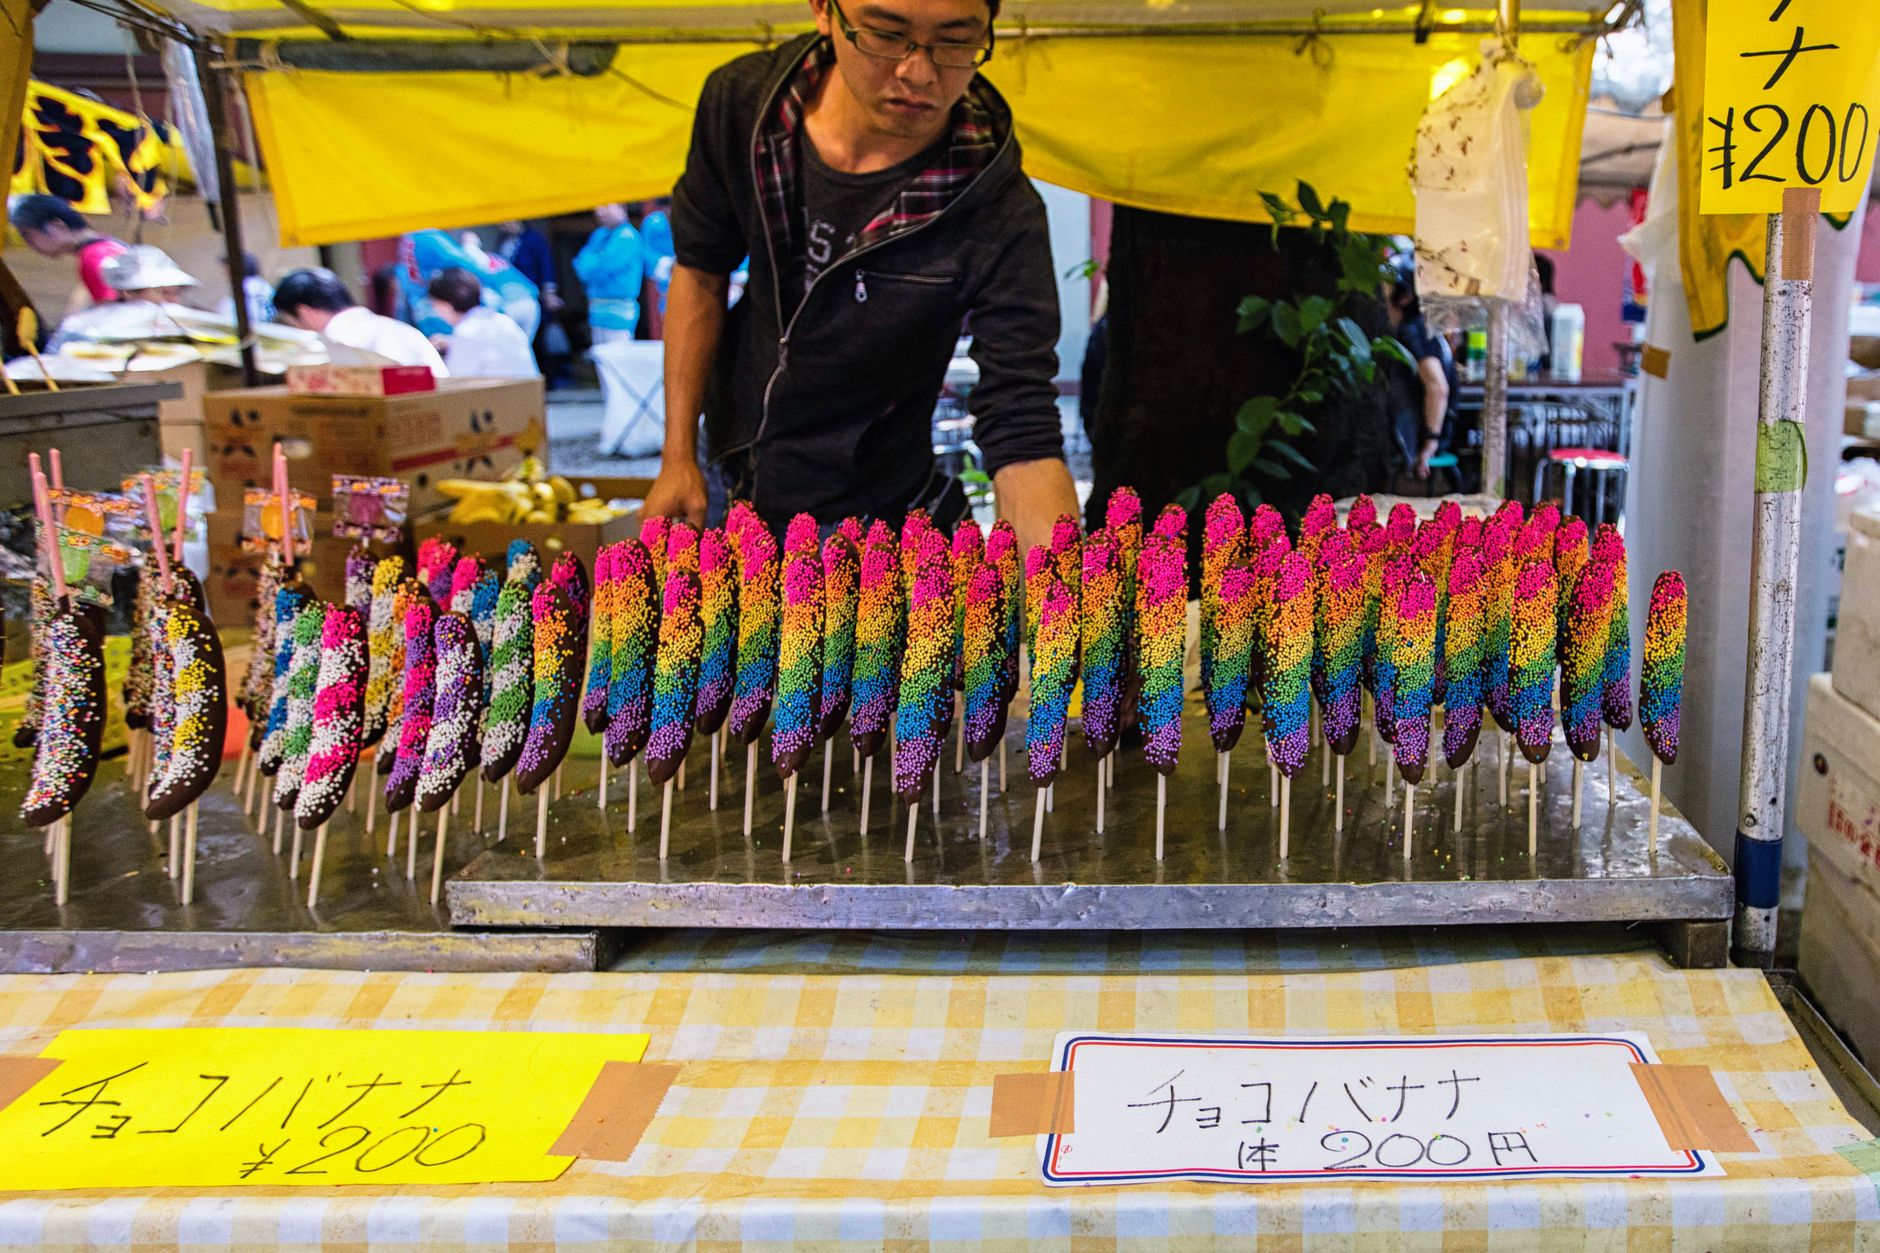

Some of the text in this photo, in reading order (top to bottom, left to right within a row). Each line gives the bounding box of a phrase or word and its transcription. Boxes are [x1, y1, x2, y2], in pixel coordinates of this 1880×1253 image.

[1739, 0, 1840, 91] ナ
[1707, 102, 1870, 190] ¥200
[38, 1060, 472, 1139] チョコバナナ
[1126, 1068, 1482, 1134] チョコバナナ
[238, 1122, 487, 1180] ¥200
